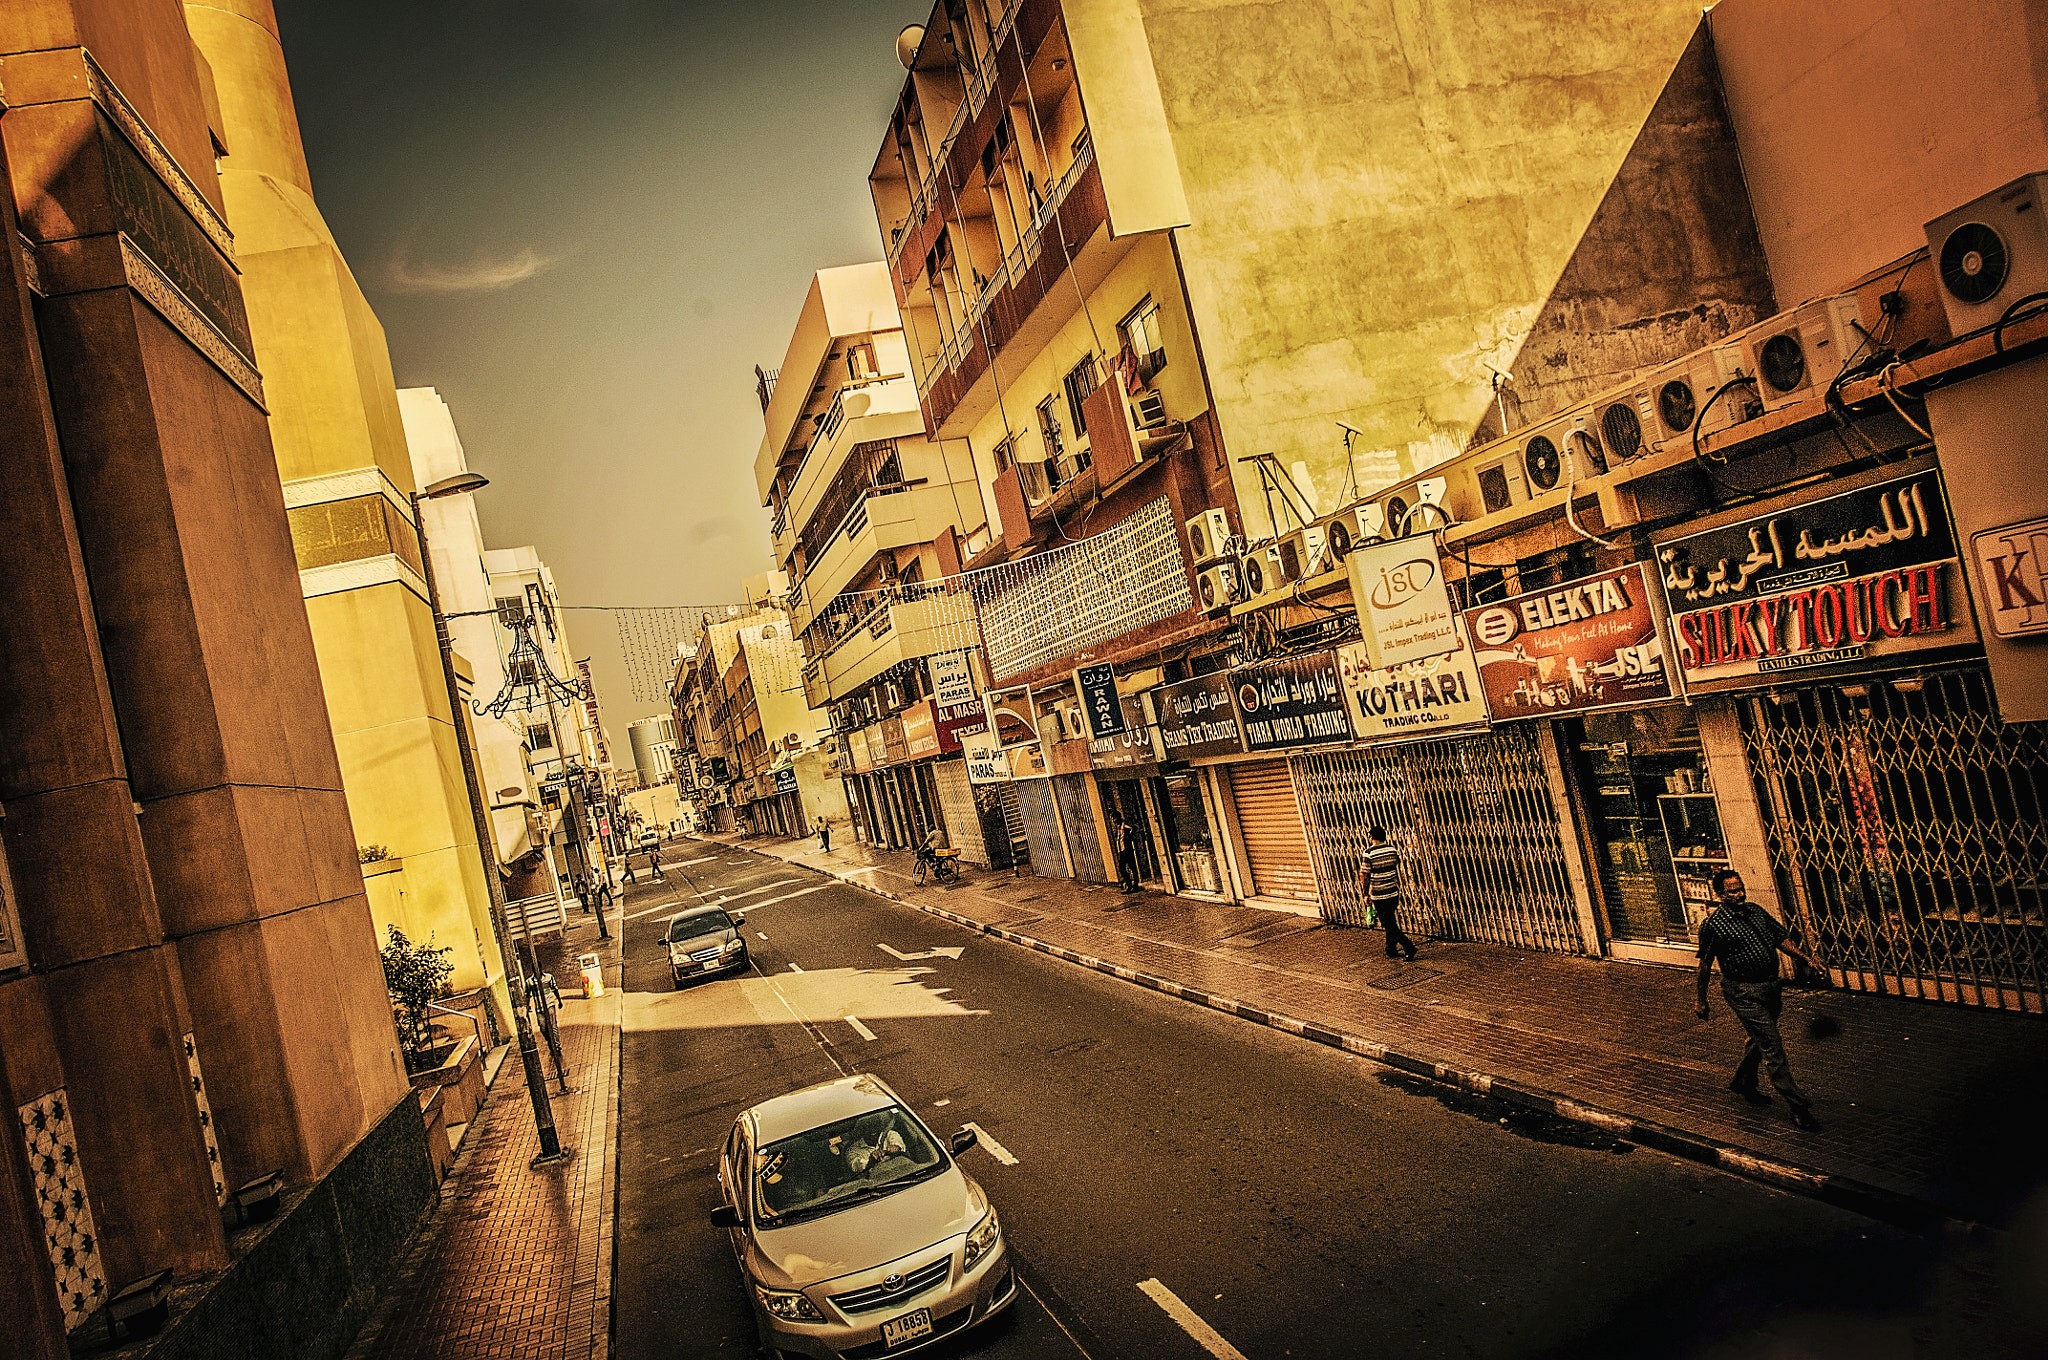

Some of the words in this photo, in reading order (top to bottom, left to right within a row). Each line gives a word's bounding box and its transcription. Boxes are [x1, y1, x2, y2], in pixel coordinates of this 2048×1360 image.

[1661, 518, 1783, 601] الحريرية
[1520, 578, 1626, 632] ELEKTA
[1679, 597, 1782, 671] SILKY
[1788, 564, 1943, 651] TOUCH
[1413, 631, 1436, 643] Trading
[1534, 631, 1563, 650] Making
[1609, 620, 1634, 637] Home
[1614, 643, 1660, 678] JSL
[1760, 657, 1800, 671] TEXTILES
[1800, 651, 1840, 665] TRADING
[940, 687, 970, 700] PARAS
[1083, 672, 1111, 685] روان
[1094, 688, 1113, 729] RAWAN
[1356, 671, 1470, 718] KOTHARI
[939, 707, 953, 722] AL
[953, 700, 983, 718] MASR
[1383, 713, 1420, 728] TRADING
[1246, 721, 1273, 744] TIARA
[1272, 716, 1304, 741] WORLD
[1304, 710, 1347, 738] TRADING
[971, 763, 995, 778] PARAS
